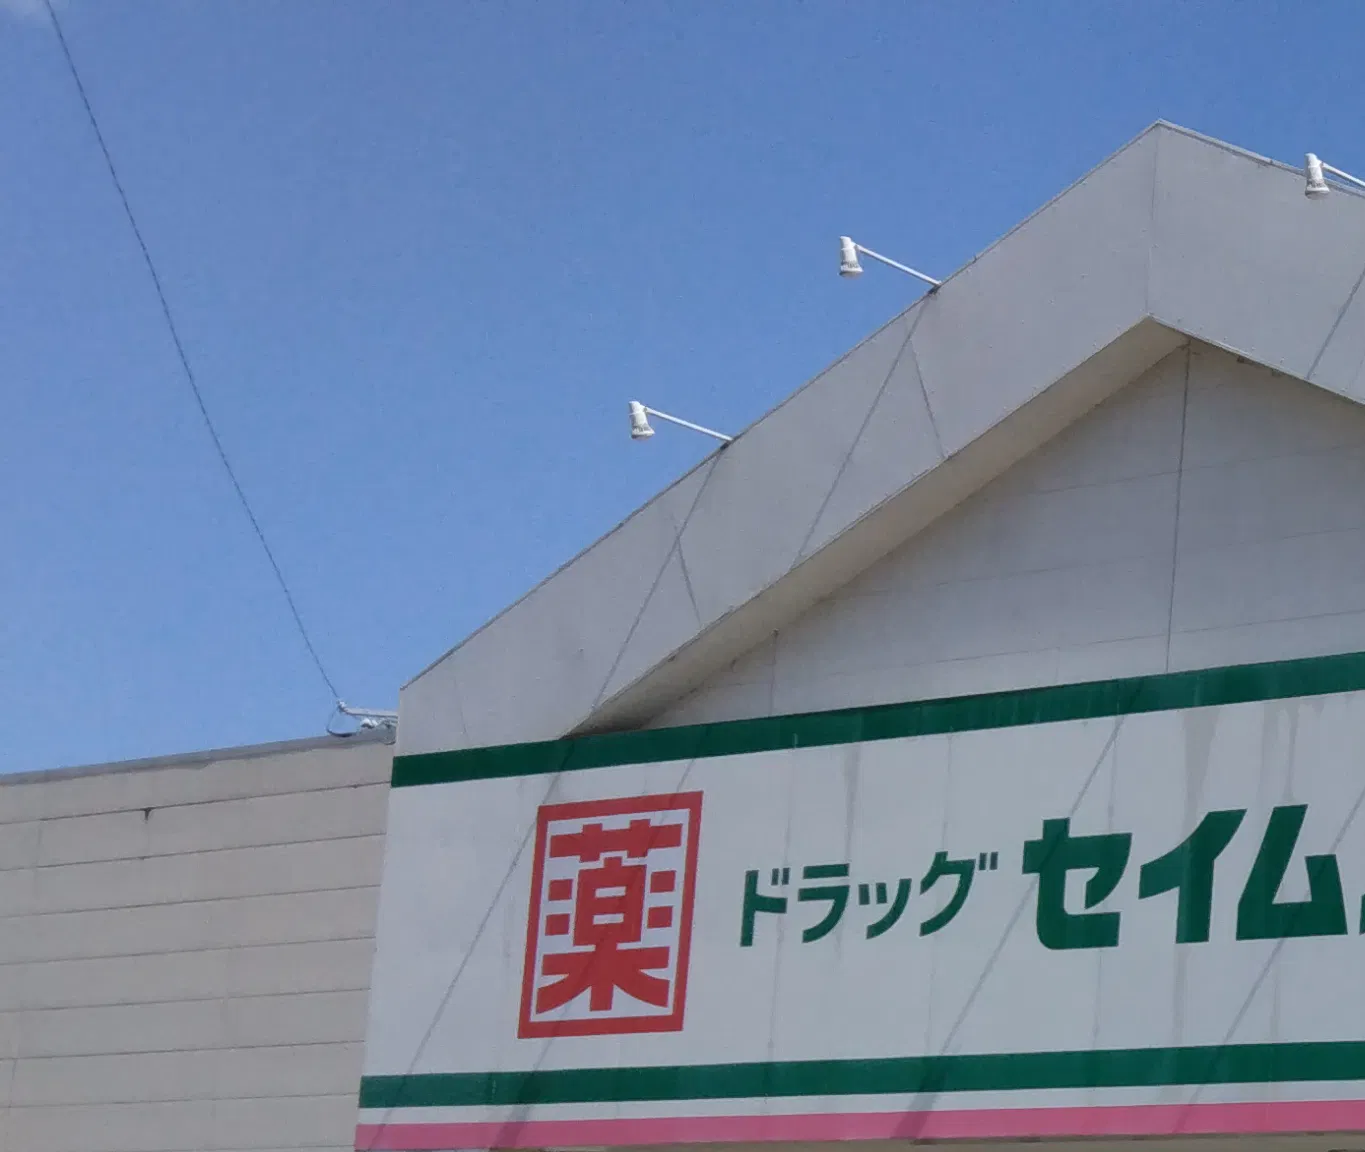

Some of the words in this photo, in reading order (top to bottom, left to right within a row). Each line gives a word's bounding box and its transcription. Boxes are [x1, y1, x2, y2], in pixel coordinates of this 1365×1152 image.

[535, 820, 682, 1014] 薬
[740, 851, 998, 947] ドラッグ
